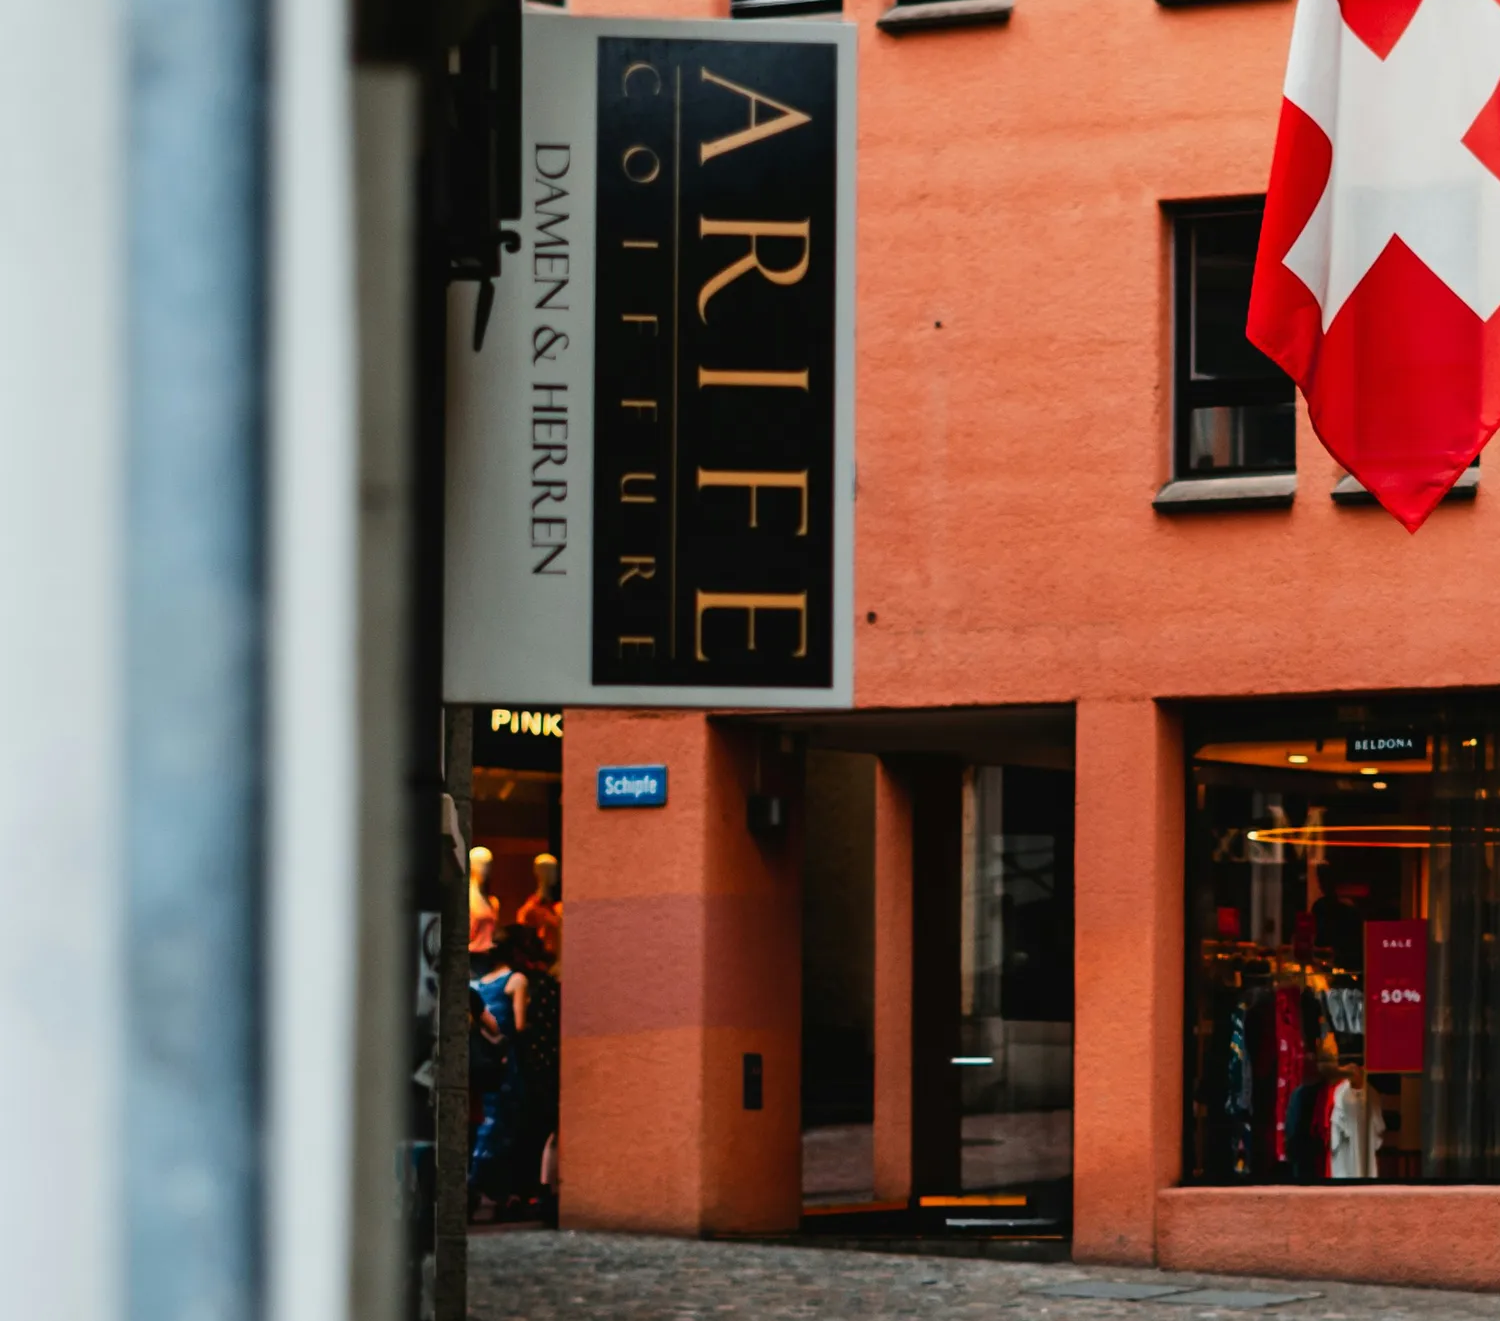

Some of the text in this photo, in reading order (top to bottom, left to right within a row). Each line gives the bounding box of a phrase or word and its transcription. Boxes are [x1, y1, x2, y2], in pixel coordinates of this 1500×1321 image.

[530, 142, 571, 576] DAMEN & HERREN
[617, 62, 660, 659] COIFFURE
[695, 67, 813, 661] ARIFE
[604, 775, 658, 798] Schipfe
[1354, 738, 1413, 751] BELDONA
[1382, 939, 1413, 948] SALE
